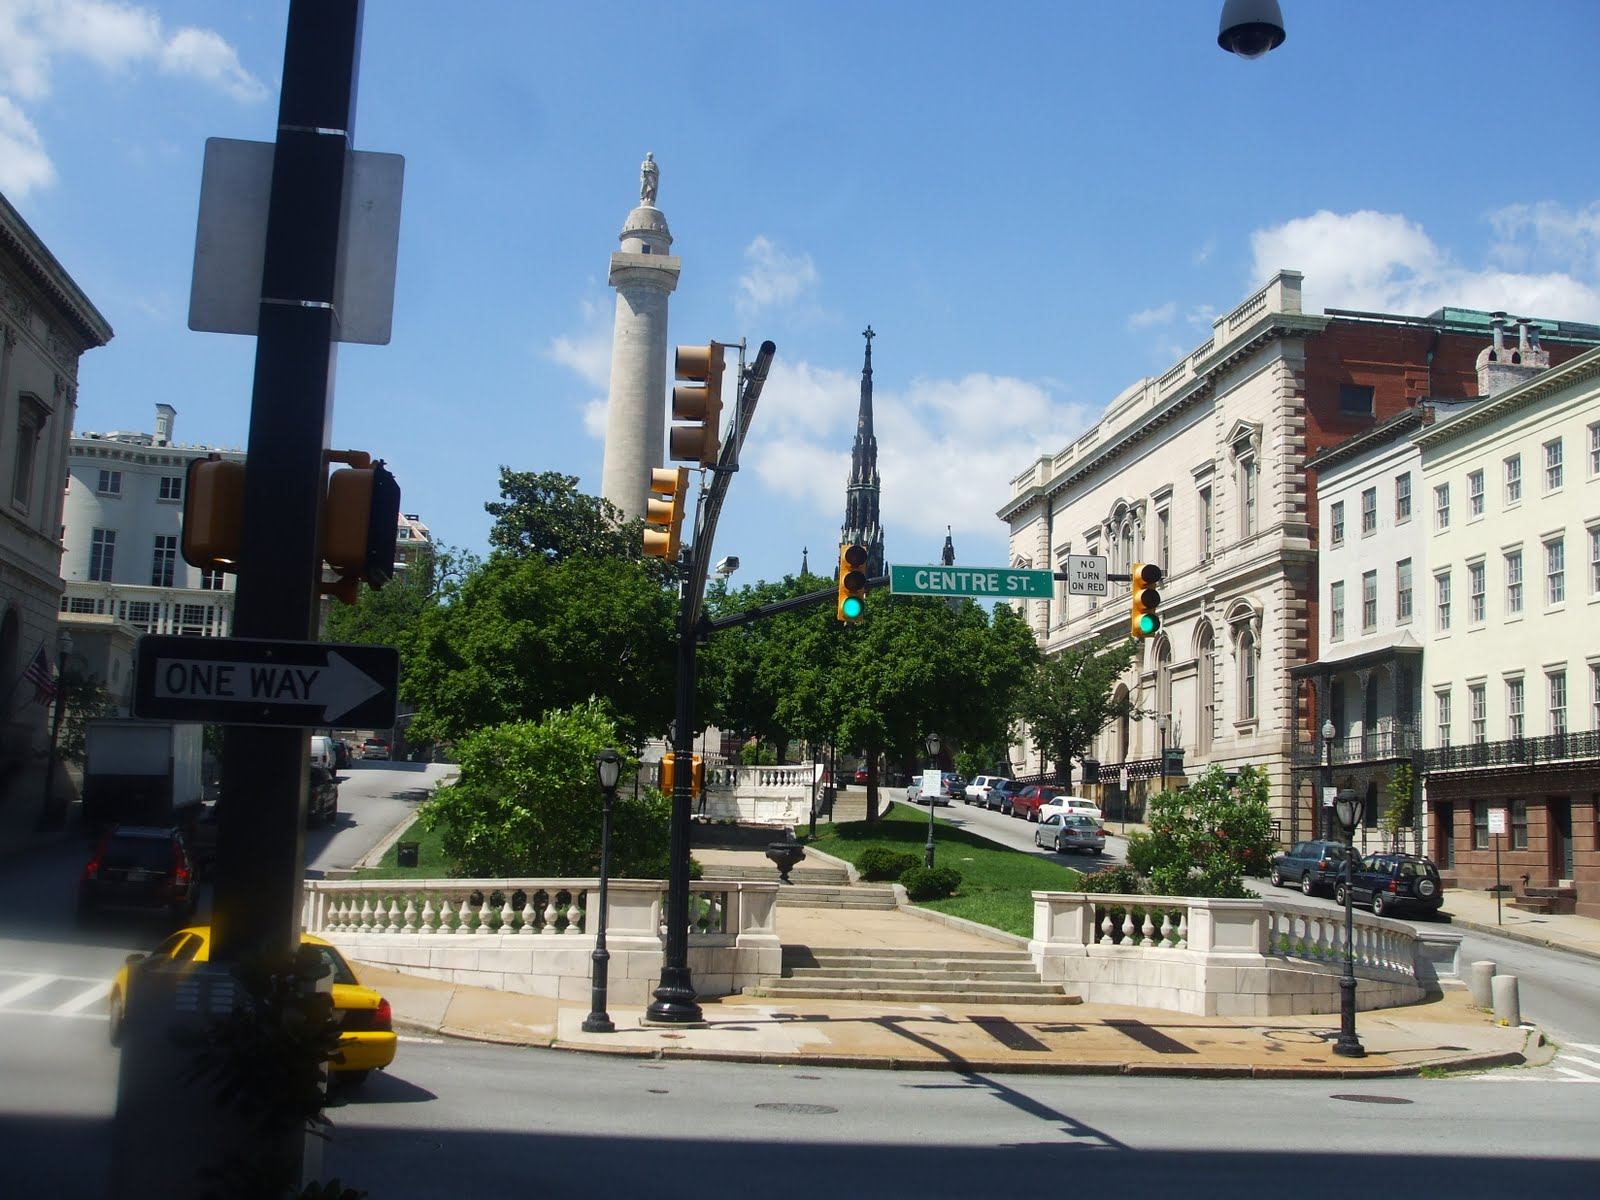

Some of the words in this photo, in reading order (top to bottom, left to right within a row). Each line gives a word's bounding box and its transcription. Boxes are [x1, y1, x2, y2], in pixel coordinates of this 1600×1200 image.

[1080, 560, 1095, 569] NO
[1076, 571, 1100, 580] TURN
[914, 570, 1000, 592] CENTRE
[1006, 575, 1035, 591] ST.
[1072, 581, 1084, 590] ON
[1087, 582, 1105, 591] RED
[165, 662, 235, 697] ONE
[251, 667, 321, 700] WAY
